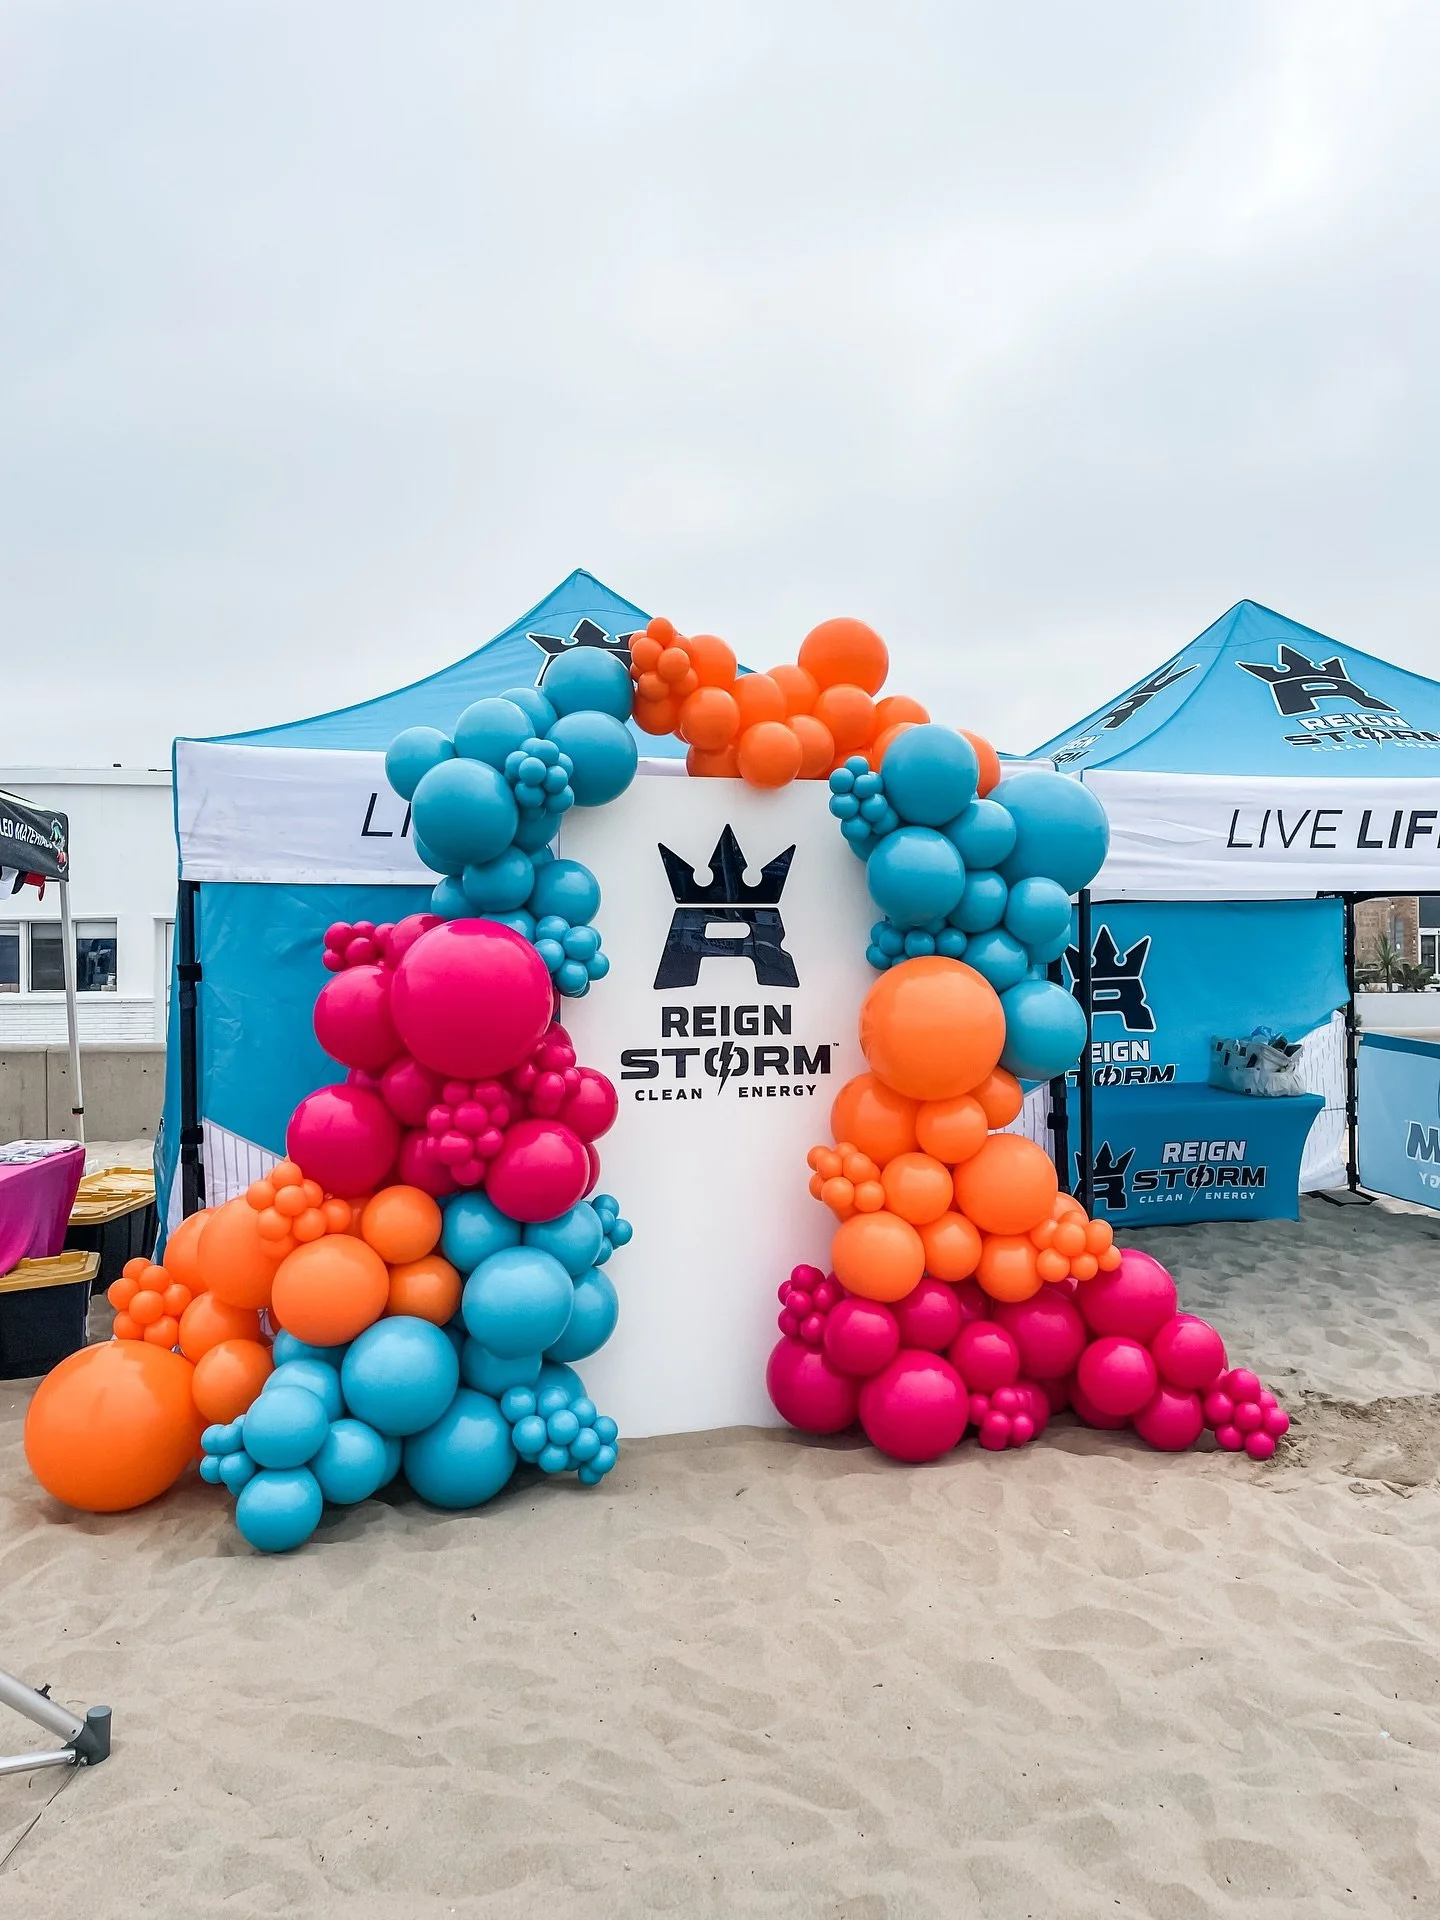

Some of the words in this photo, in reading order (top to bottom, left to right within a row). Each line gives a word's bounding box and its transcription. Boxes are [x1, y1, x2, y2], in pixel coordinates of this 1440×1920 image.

[1297, 713, 1413, 731] REIGN
[1226, 809, 1343, 849] LIVE
[1356, 809, 1440, 849] LIF
[662, 1004, 792, 1038] REIGN
[1089, 1040, 1150, 1065] EIGN
[634, 1087, 703, 1102] CLEAN
[738, 1084, 817, 1099] ENERGY
[1162, 1140, 1247, 1164] REIGN
[1131, 1163, 1267, 1194] STORM
[1139, 1193, 1183, 1204] CLEAN
[1205, 1191, 1256, 1200] ENERGY
